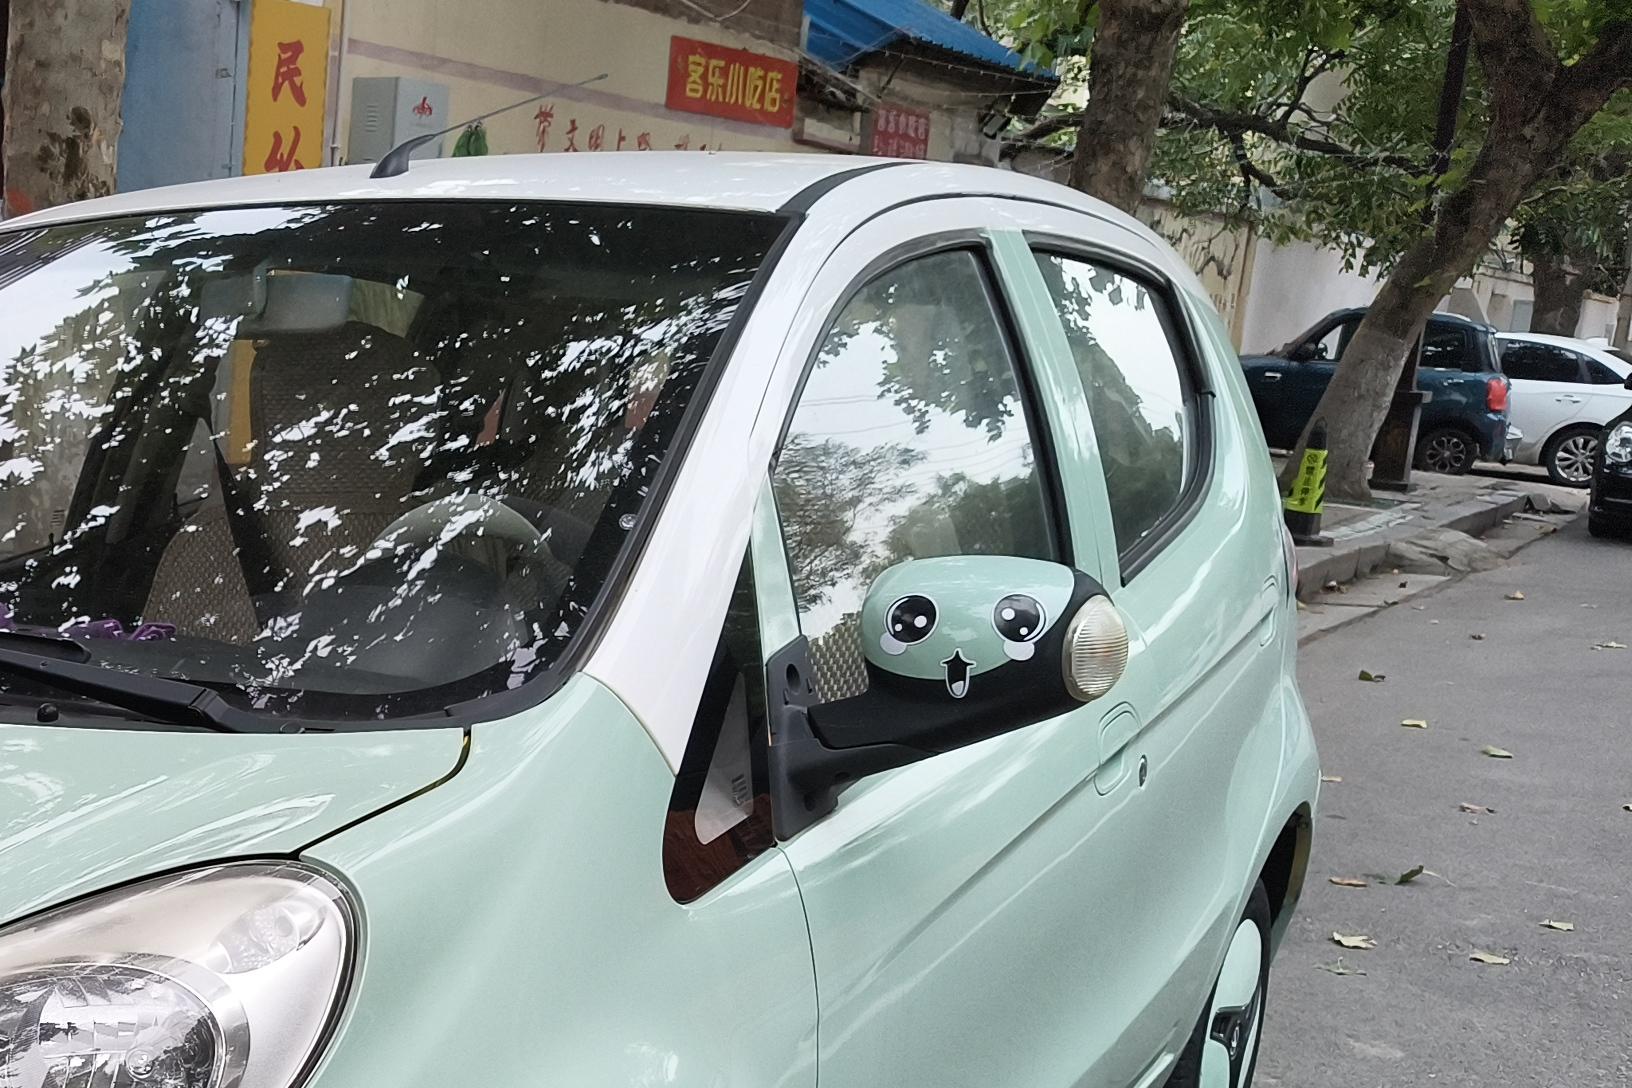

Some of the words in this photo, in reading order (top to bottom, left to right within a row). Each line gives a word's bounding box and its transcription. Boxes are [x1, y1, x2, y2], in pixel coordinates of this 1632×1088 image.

[686, 54, 783, 112] 客乐小吃店
